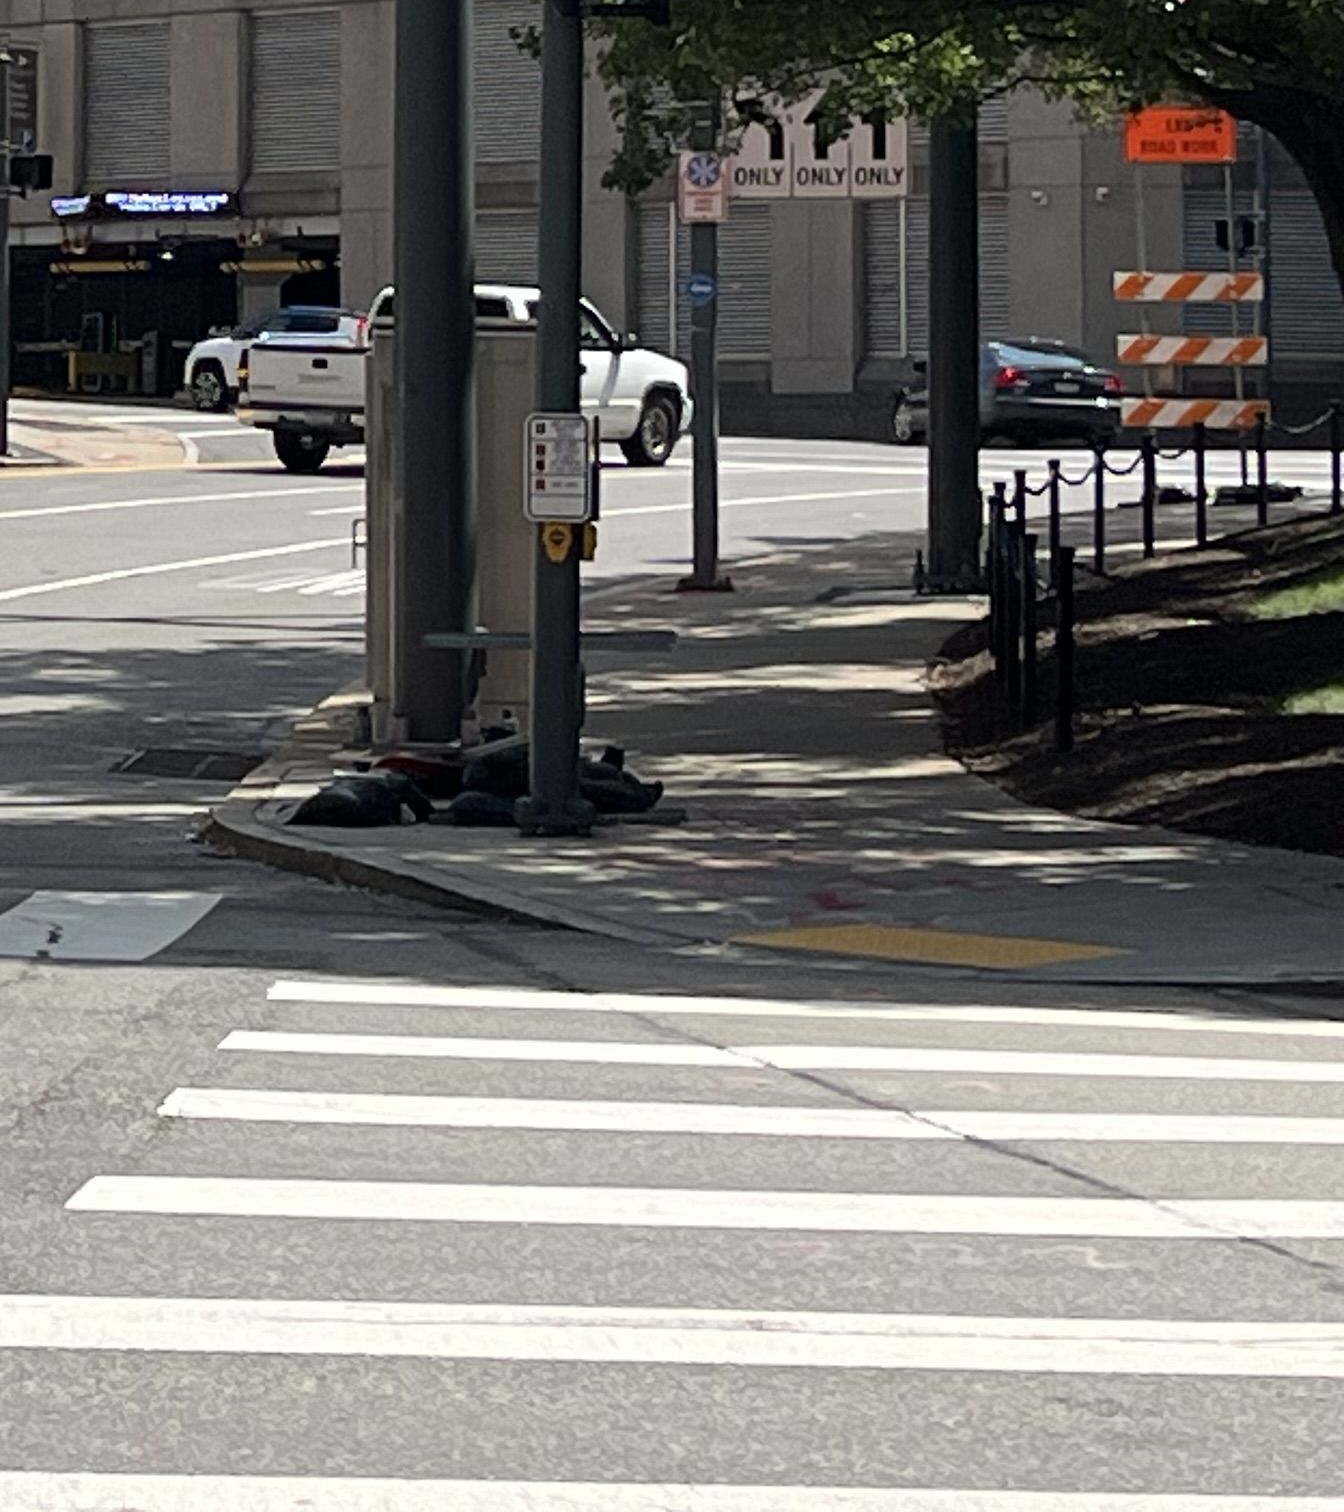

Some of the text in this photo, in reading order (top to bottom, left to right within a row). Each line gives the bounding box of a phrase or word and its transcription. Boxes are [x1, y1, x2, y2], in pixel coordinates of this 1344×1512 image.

[733, 167, 784, 186] ONLY
[796, 167, 847, 186] ONLY
[854, 167, 905, 186] ONLY
